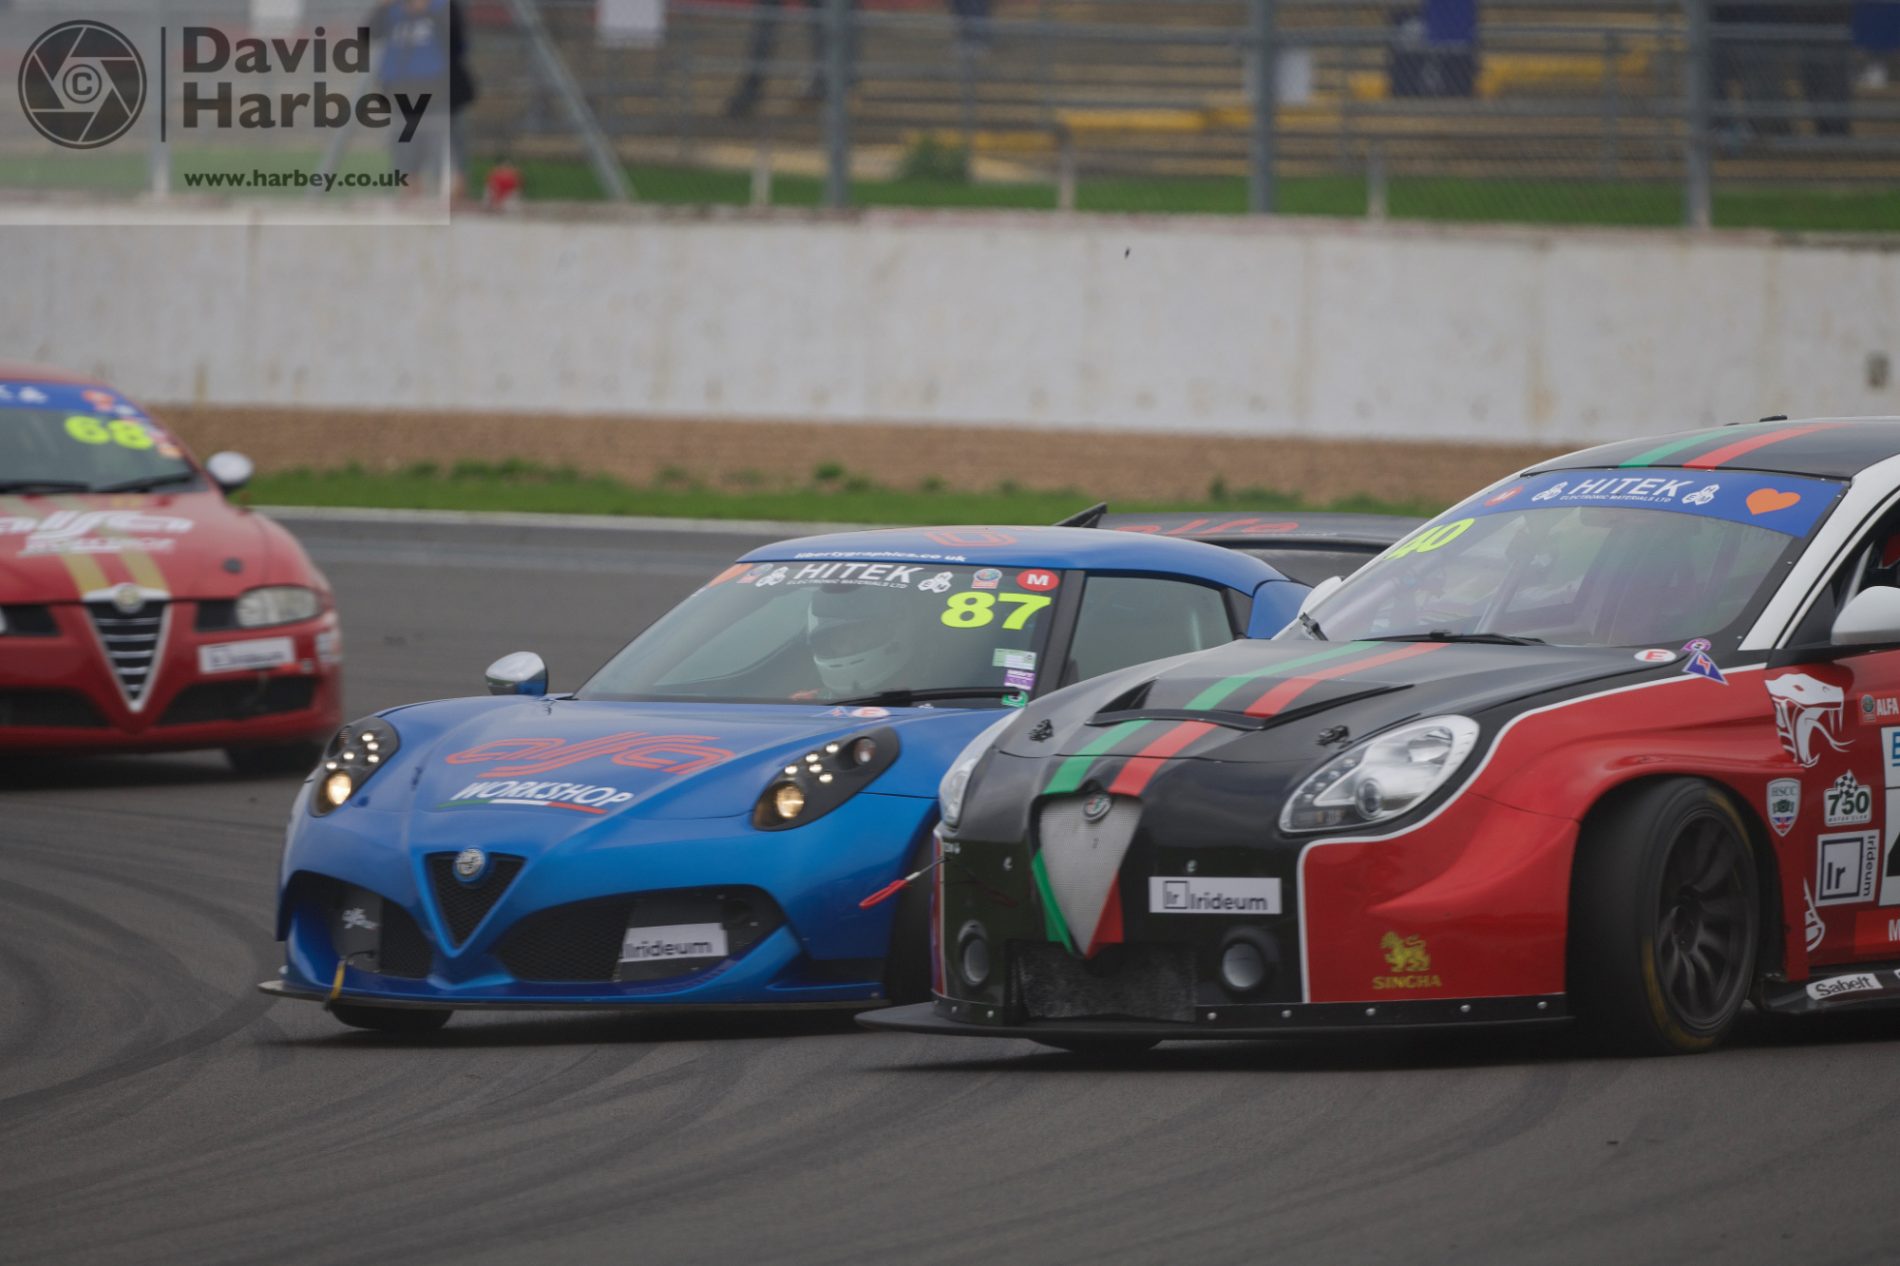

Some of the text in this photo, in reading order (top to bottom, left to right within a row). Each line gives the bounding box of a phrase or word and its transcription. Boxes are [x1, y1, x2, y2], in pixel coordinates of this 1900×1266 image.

[65, 415, 152, 449] 68
[1567, 478, 1695, 497] HITEK
[793, 563, 925, 584] HITEK
[1027, 573, 1050, 586] M
[941, 591, 1052, 630] 87
[1644, 650, 1669, 662] E
[1876, 697, 1900, 717] ALFA
[451, 780, 635, 807] WORKSHOP
[1828, 790, 1870, 816] 750
[1826, 861, 1847, 891] Ir
[1863, 834, 1877, 897] Irideum
[1190, 891, 1268, 910] Irideum
[1815, 975, 1874, 997] Sabelt
